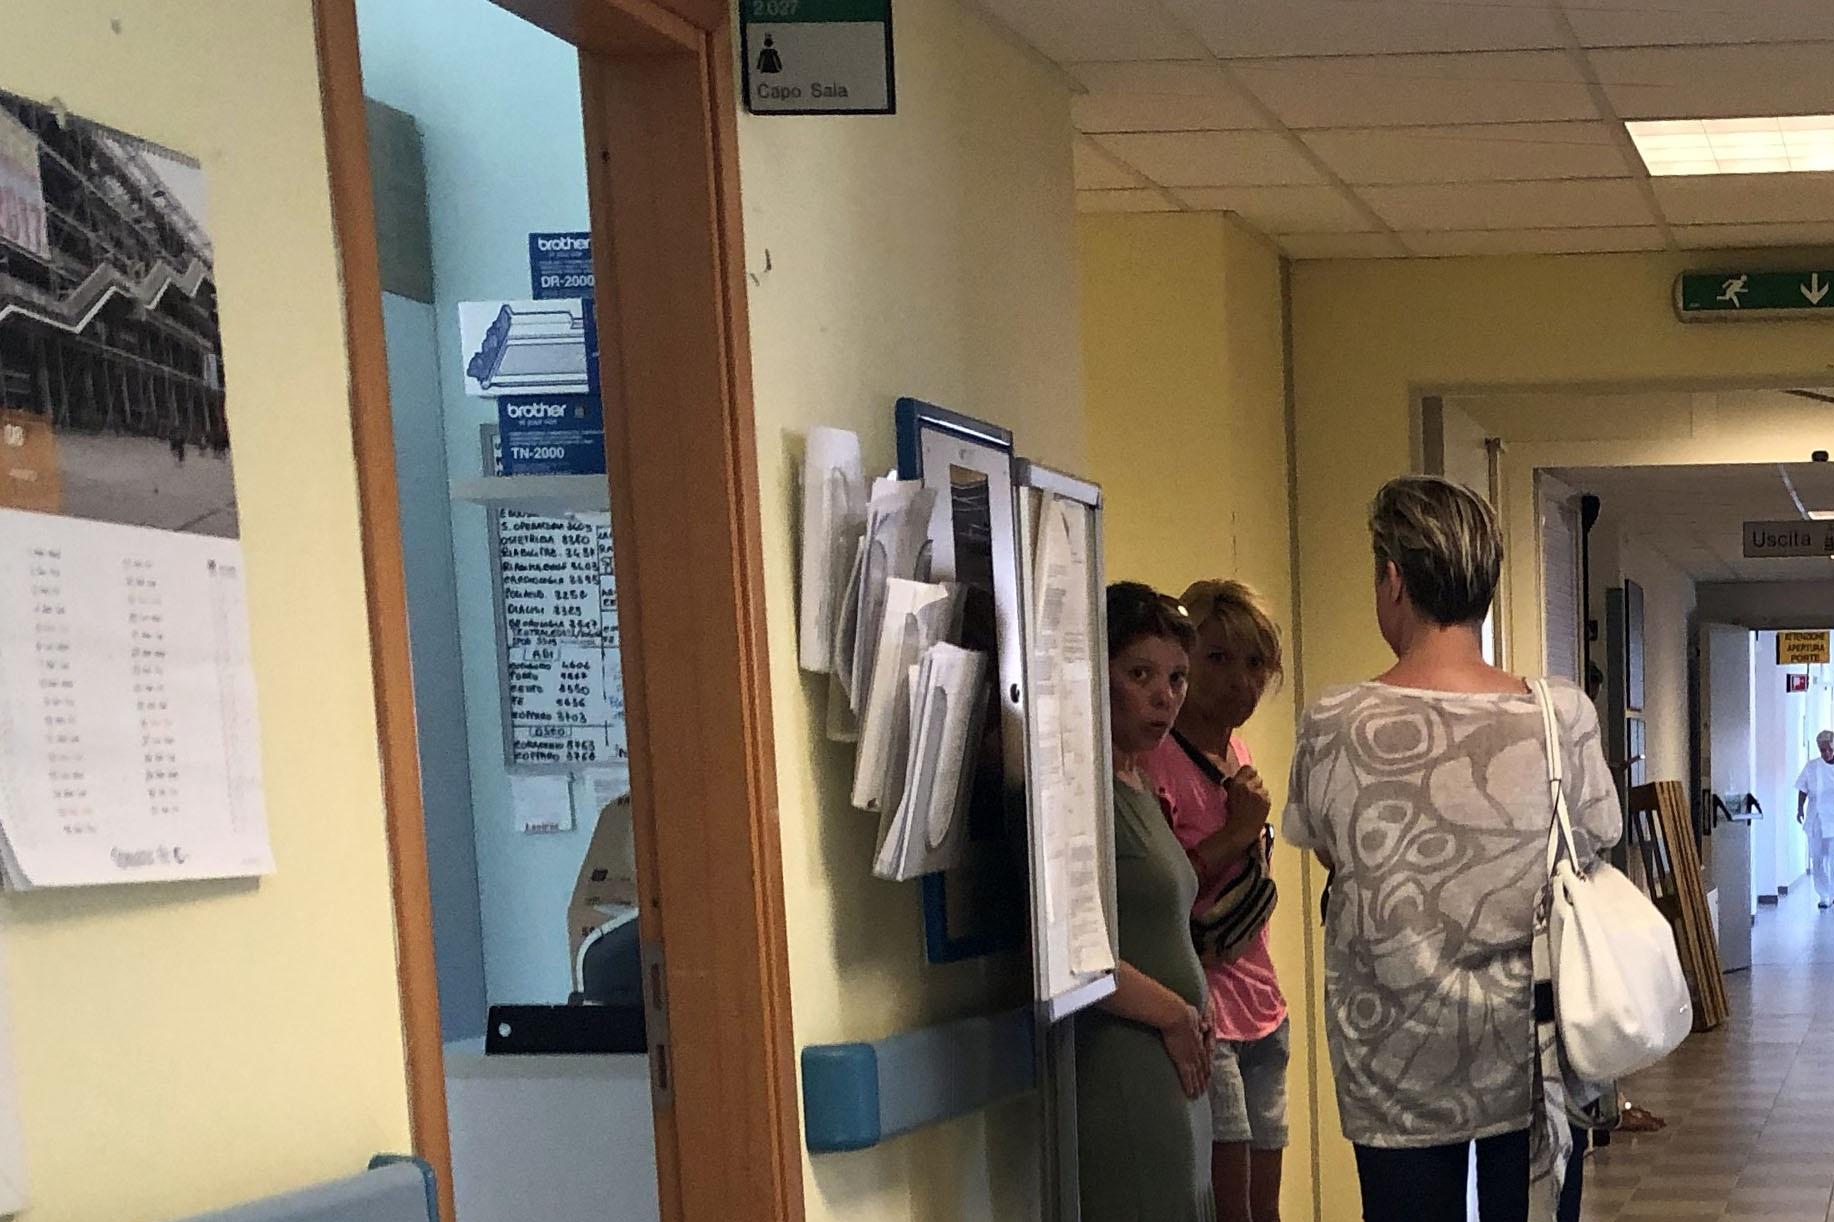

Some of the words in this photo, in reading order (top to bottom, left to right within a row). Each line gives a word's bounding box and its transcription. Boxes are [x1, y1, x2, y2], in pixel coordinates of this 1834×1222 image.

[757, 83, 802, 101] Capo
[810, 81, 849, 98] Sala
[537, 236, 592, 251] brother
[541, 275, 595, 288] DR-2000
[507, 402, 567, 418] brother
[511, 446, 565, 459] TN-2000
[1752, 529, 1812, 549] Uscita
[1784, 632, 1826, 641] ATTENZIONE
[1786, 644, 1825, 652] APERTURA
[1790, 654, 1820, 663] PORTE
